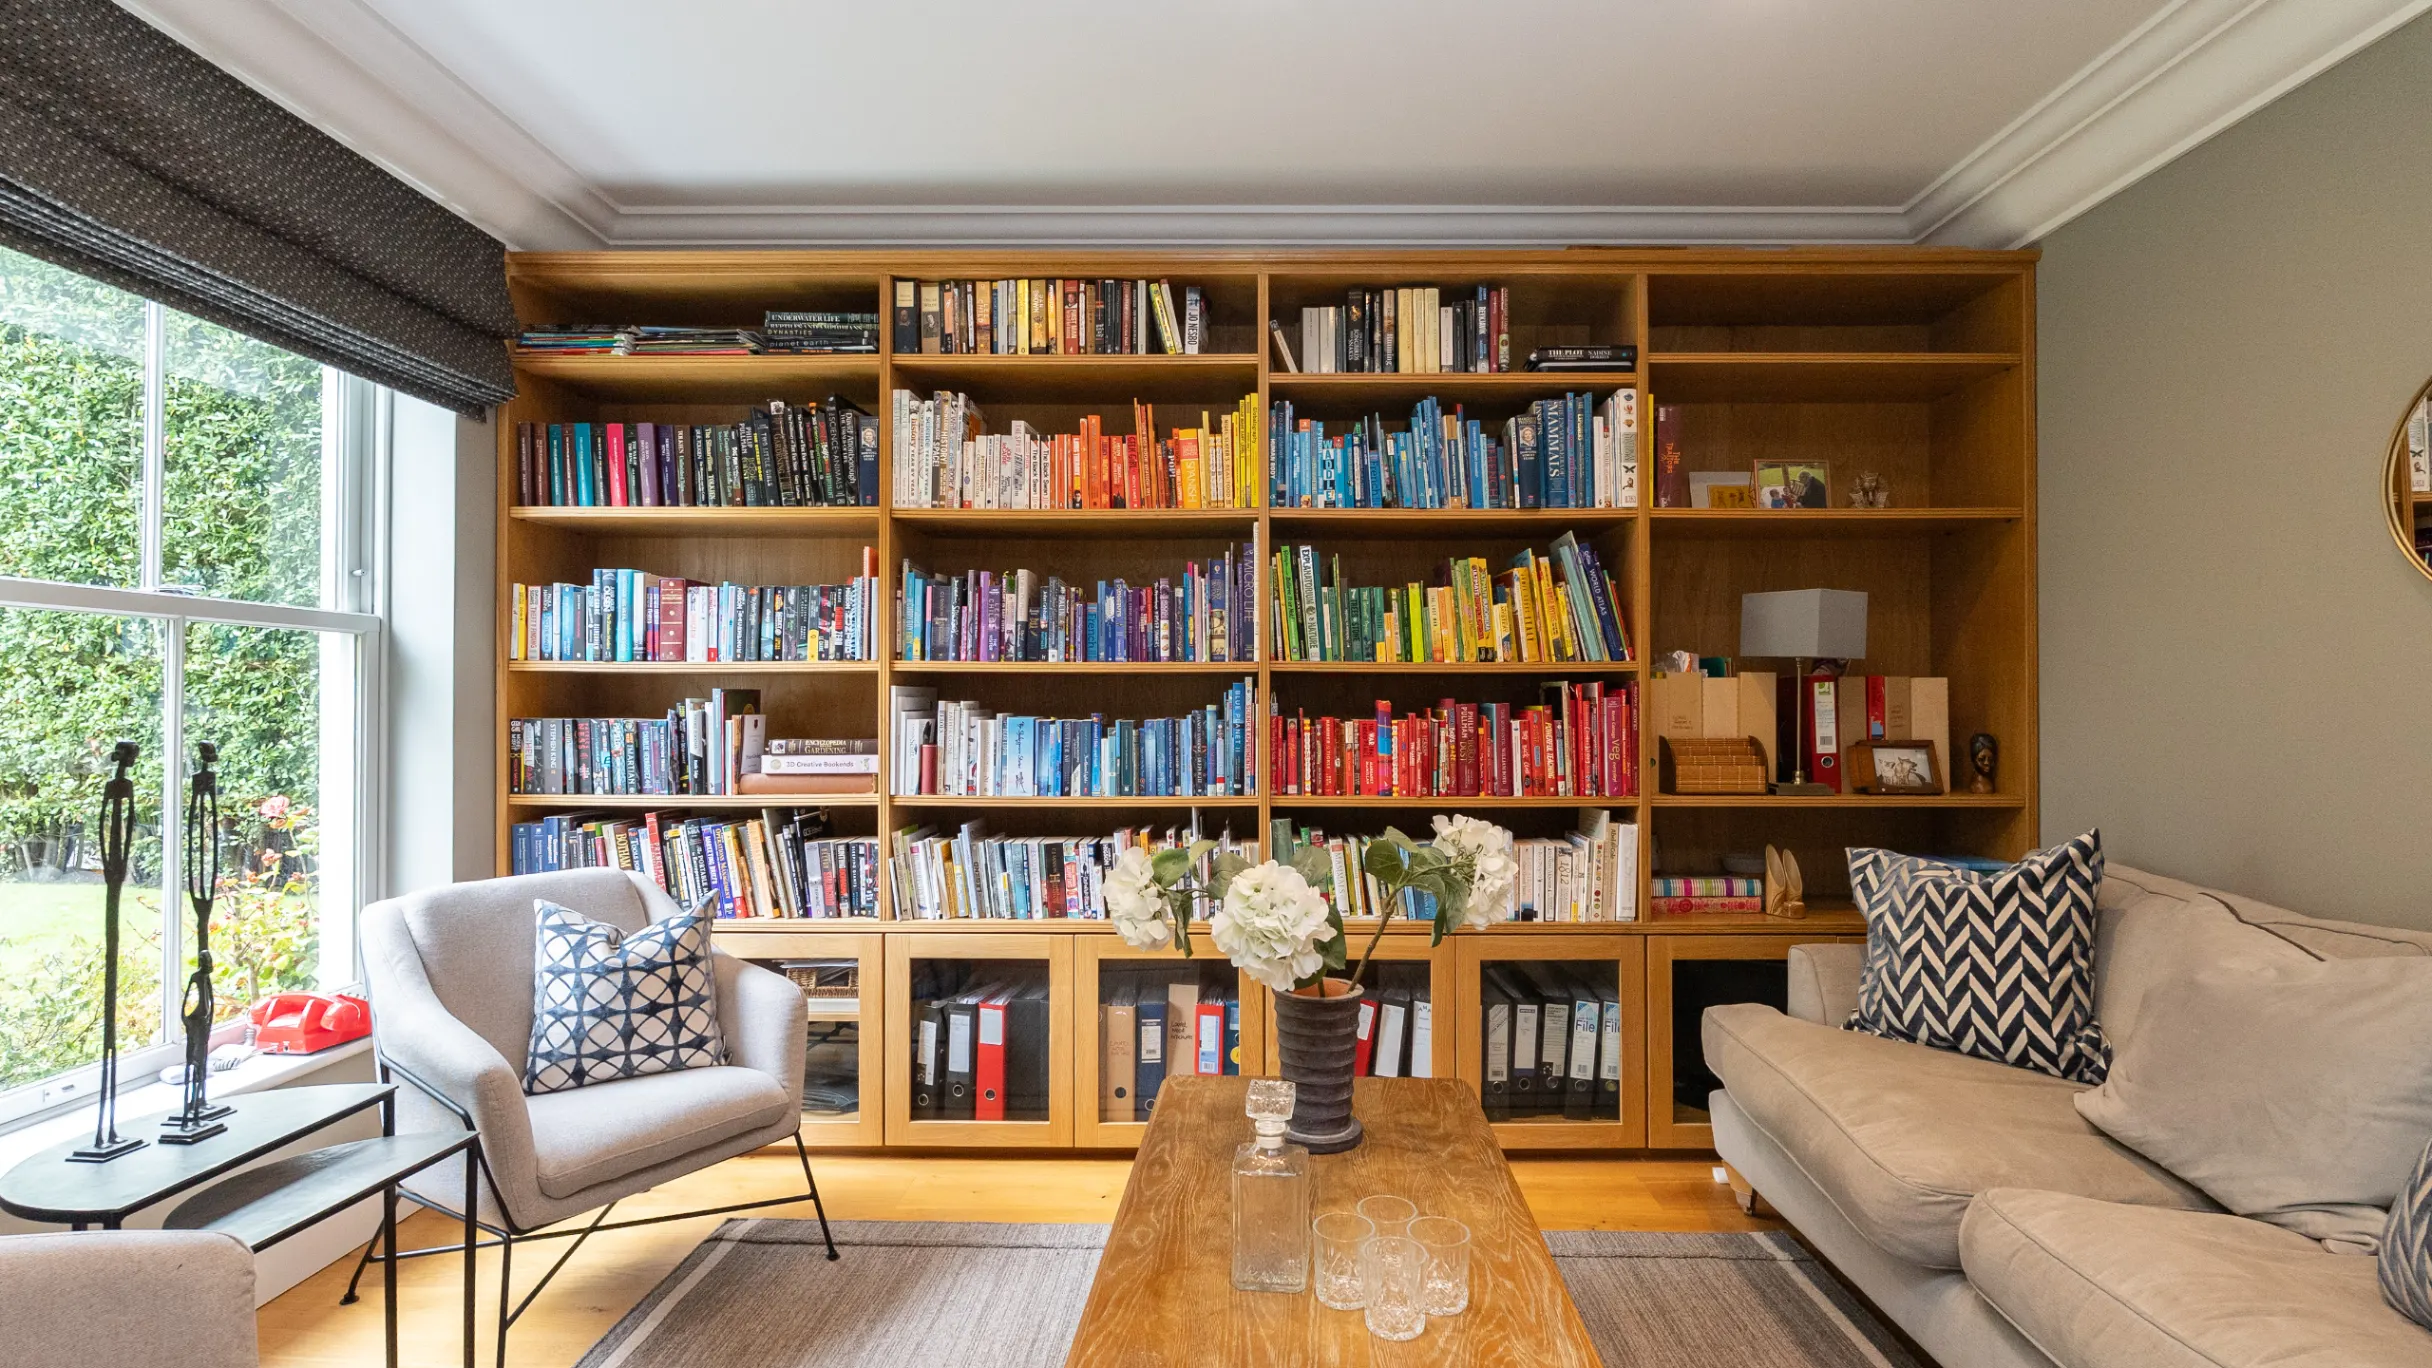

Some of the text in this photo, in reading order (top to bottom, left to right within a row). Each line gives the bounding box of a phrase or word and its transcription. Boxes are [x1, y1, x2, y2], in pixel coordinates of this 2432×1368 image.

[1189, 312, 1197, 321] JO
[1385, 334, 1394, 366] Running
[740, 423, 748, 454] PULLMAN
[846, 412, 856, 484] David Attenborough
[909, 418, 918, 447] history
[1547, 404, 1560, 477] MAMMALS
[772, 433, 784, 473] GARDENING
[829, 417, 842, 489] SCIENCE ANIMALS
[1014, 453, 1022, 476] TRAITOR
[1128, 454, 1136, 468] GIRL
[1186, 461, 1197, 502] SPANISH
[1371, 461, 1380, 496] French
[1487, 449, 1498, 496] FRENCH
[603, 586, 611, 612] OLSEN
[1244, 559, 1254, 622] MICRO LIFE
[1302, 549, 1318, 648] EXPLANATORIUM NATURE
[1590, 569, 1599, 594] WORLD
[1596, 596, 1607, 616] ATLAS
[1088, 613, 1096, 648] French
[627, 750, 635, 784] MARTIAN
[1545, 722, 1555, 779] POWERFUL TEACHING
[1609, 739, 1620, 761] veg
[616, 833, 631, 868] BOTHAM
[654, 842, 665, 888] PRINCIPLES
[705, 836, 715, 865] MARKETING
[715, 828, 730, 898] OPERATIONS MANAGEMENT
[698, 856, 707, 886] PORTABLE
[823, 871, 834, 906] STALINGRAD
[1335, 853, 1345, 894] MAMMALS
[1558, 861, 1570, 885] 1812
[1576, 1020, 1595, 1033] File
